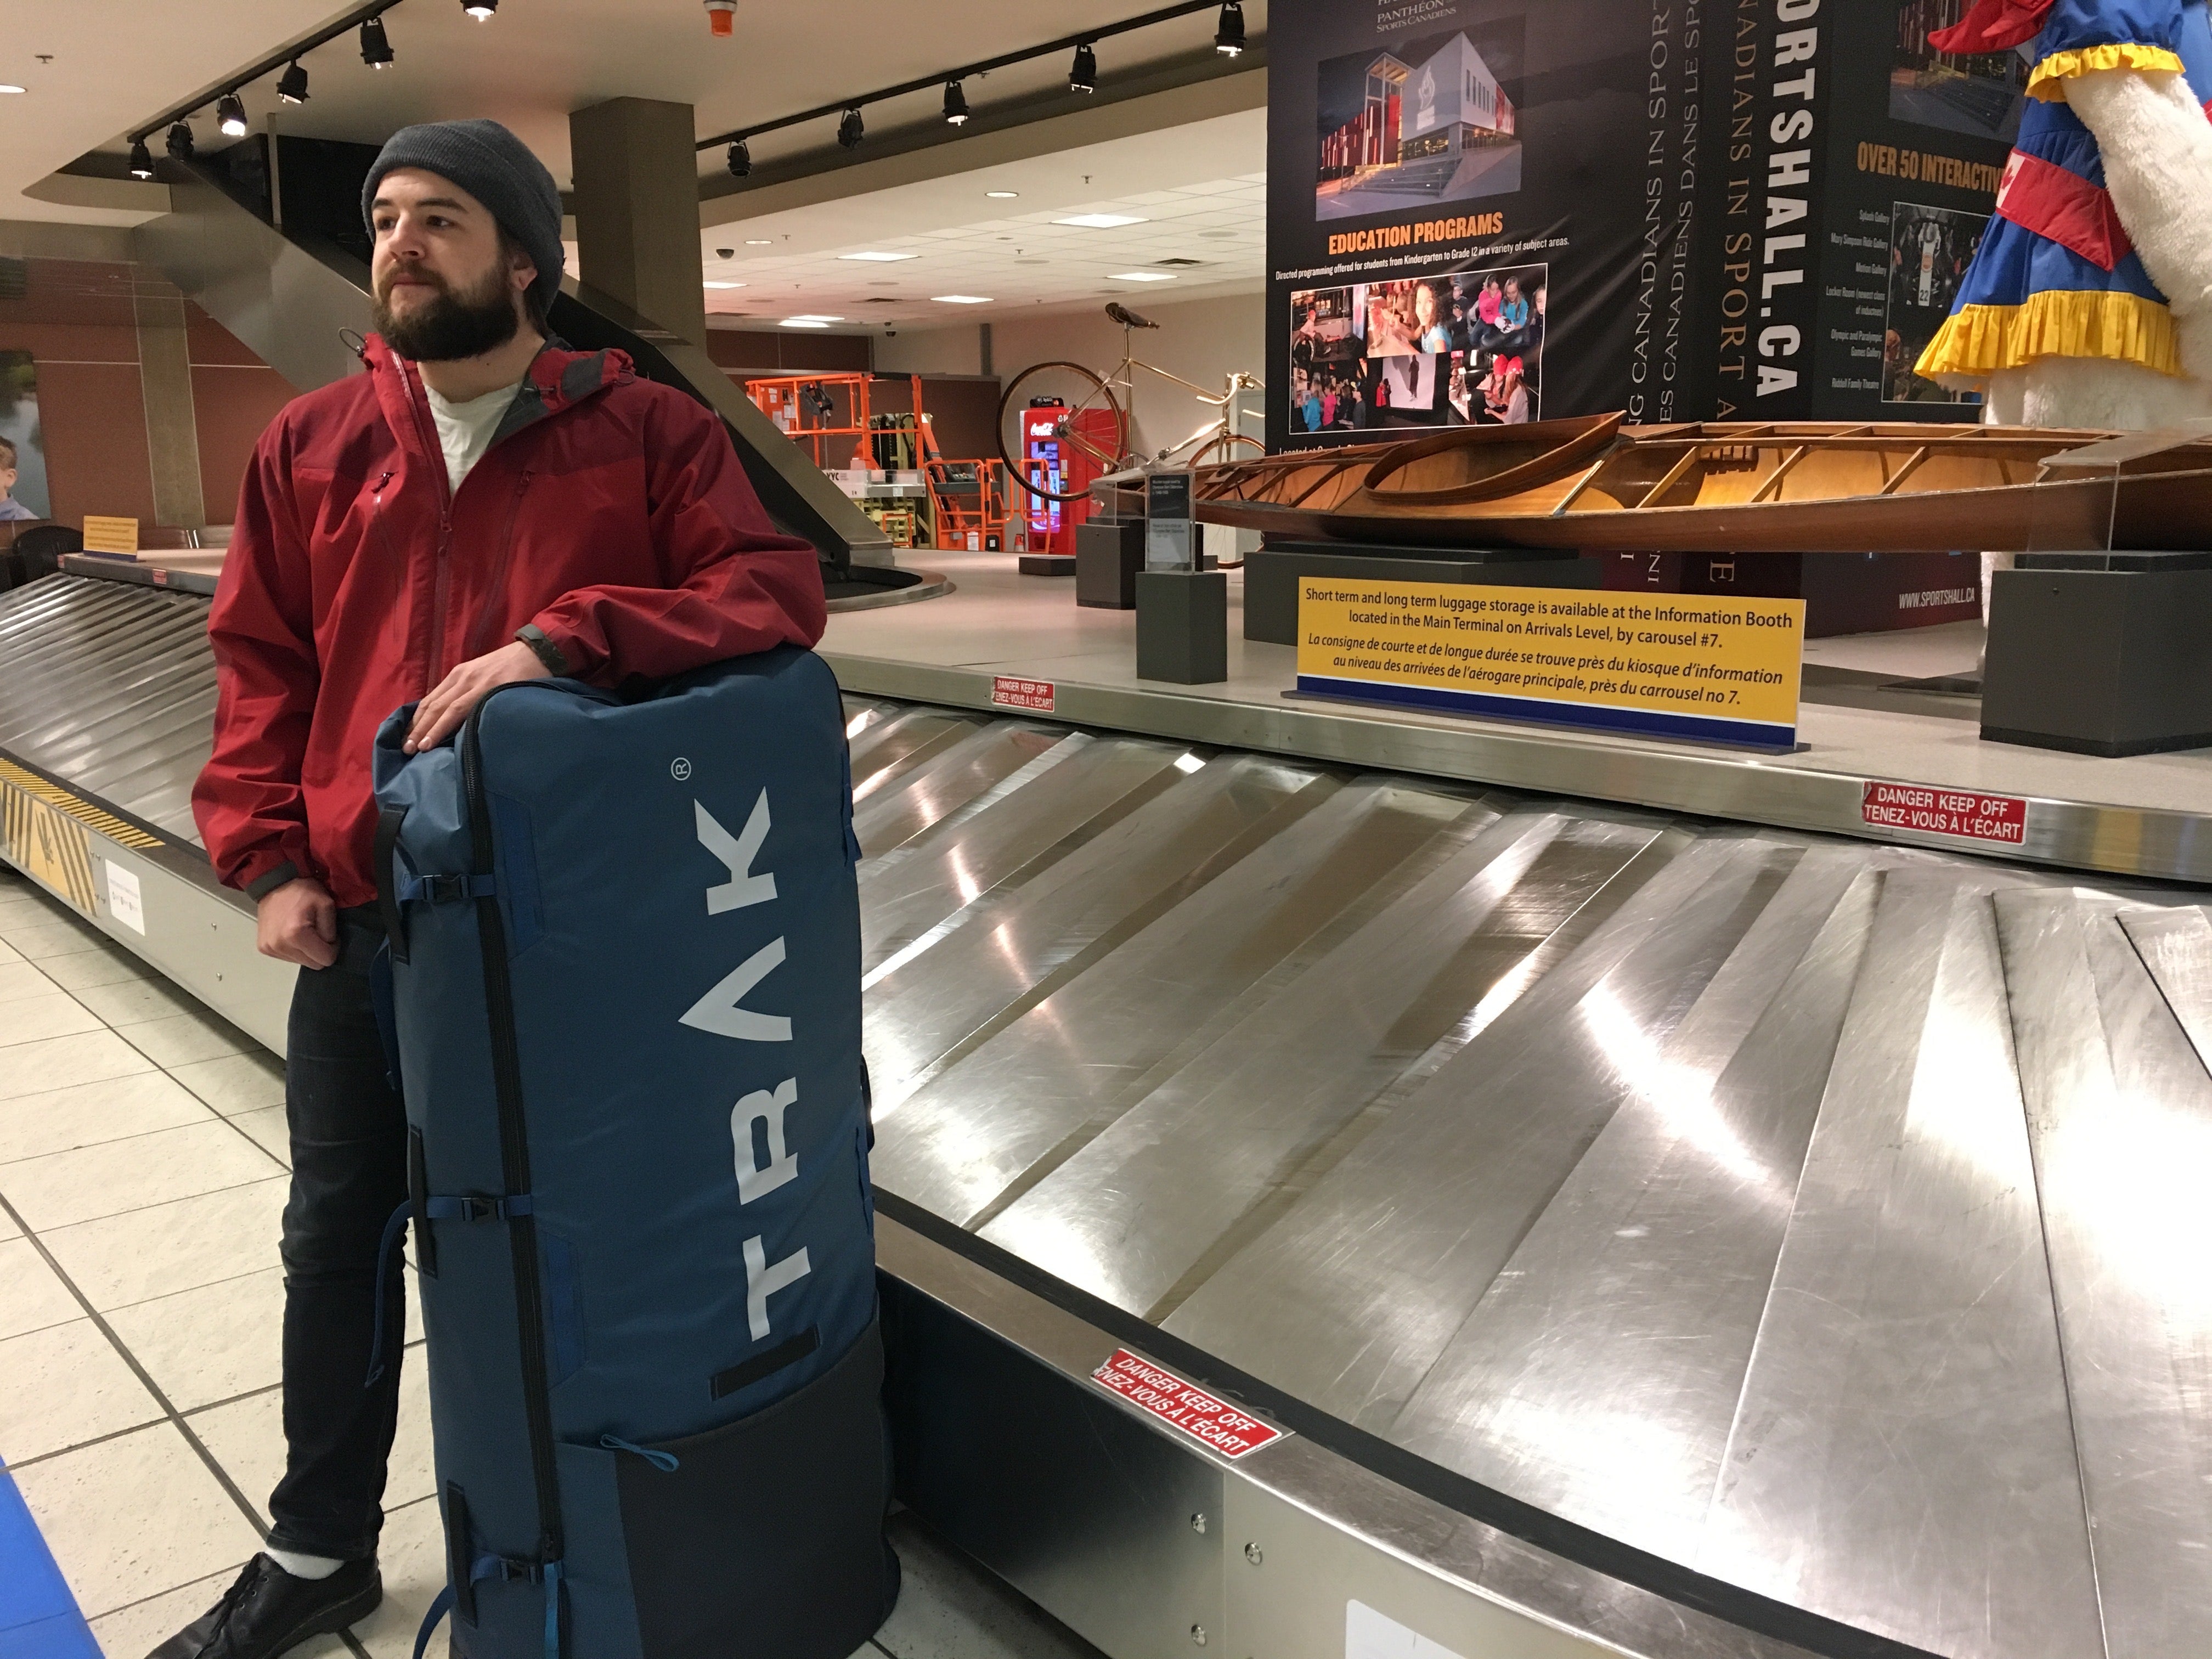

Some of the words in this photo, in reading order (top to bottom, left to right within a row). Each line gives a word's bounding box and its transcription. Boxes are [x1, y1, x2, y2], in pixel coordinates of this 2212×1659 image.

[1376, 19, 1407, 33] SPORTS
[1408, 7, 1456, 25] CANADIENS
[1378, 0, 1444, 23] PANTHÉON
[1685, 57, 1699, 94] LE
[1680, 104, 1699, 191] DANS
[1858, 141, 1897, 176] OVER
[1900, 149, 1919, 179] 50
[1921, 153, 2006, 195] INTERACTIV
[1728, 177, 1750, 215] IN
[1329, 224, 1410, 255] EDUCATION
[1414, 211, 1503, 244] PROGRAMS
[1276, 268, 1297, 280] Directed
[1298, 266, 1333, 279] programming
[1334, 262, 1353, 274] offered
[1364, 258, 1389, 270] students
[1389, 257, 1403, 267] from
[1404, 252, 1442, 265] Kindergarten
[1443, 251, 1451, 259] to
[1452, 247, 1470, 259] Grade
[1479, 246, 1486, 256] in
[1491, 242, 1514, 255] variety
[1515, 241, 1522, 251] of
[1522, 239, 1547, 251] subject
[1549, 237, 1570, 247] areas.
[1632, 177, 1662, 383] CANADIANS
[1648, 129, 1664, 166] IN
[1663, 200, 1693, 381] CANADIENS
[1719, 233, 1752, 380] SPORT
[1920, 289, 1929, 301] 22
[1660, 390, 1673, 423] ES
[1306, 588, 1333, 601] Short
[1335, 591, 1359, 602] term
[1362, 592, 1381, 604] and
[1384, 592, 1408, 609] long
[1411, 596, 1436, 607] term
[1440, 595, 1487, 613] luggage
[1489, 600, 1535, 616] storage
[1538, 601, 1547, 614] is
[1550, 602, 1609, 618] available
[1612, 606, 1625, 619] at
[1629, 605, 1651, 620] the
[1655, 607, 1741, 625] Information
[1746, 611, 1792, 628] Booth
[1899, 587, 1975, 610] WWW.SPORTSHALL.CA
[1350, 610, 1387, 624] located
[1390, 613, 1400, 625] in
[1403, 613, 1420, 627] the
[1423, 615, 1451, 629] Main
[1453, 617, 1503, 632] Terminal
[1506, 623, 1522, 634] on
[1525, 622, 1572, 637] Arrivals
[1576, 625, 1613, 642] Level,
[1617, 627, 1633, 645] by
[1637, 631, 1696, 646] carousel
[1701, 634, 1723, 648] #7.
[1309, 633, 1319, 645] La
[1322, 635, 1365, 651] consigne
[1367, 637, 1379, 650] de
[1381, 639, 1414, 653] courte
[1417, 643, 1427, 654] et
[1429, 642, 1442, 656] de
[1444, 643, 1483, 661] longue
[1485, 647, 1519, 662] durée
[1521, 653, 1533, 664] se
[1536, 652, 1576, 667] trouve
[1577, 656, 1604, 671] près
[1607, 657, 1624, 671] du
[1627, 658, 1679, 678] kiosque
[1683, 662, 1783, 685] d'information
[997, 680, 1019, 692] DANGER
[1020, 682, 1035, 694] KEEP
[1036, 685, 1048, 695] OFF
[1025, 693, 1030, 705] À
[1334, 656, 1346, 666] au
[1348, 657, 1381, 670] niveau
[1384, 659, 1401, 672] des
[1403, 662, 1445, 676] arrivées
[1447, 664, 1461, 678] de
[1463, 665, 1521, 685] l'aérogare
[1522, 673, 1587, 692] principale,
[1589, 679, 1617, 694] près
[1620, 680, 1637, 695] du
[1640, 686, 1703, 702] carrousel
[1706, 691, 1725, 703] no
[1728, 690, 1741, 705] 7.
[1865, 804, 1947, 830] TENEZ-VOUS
[1949, 811, 1960, 832] À
[1963, 815, 2021, 839] L'ÉCART
[1878, 787, 1933, 808] DANGER
[1939, 794, 1976, 813] KEEP
[1980, 799, 2008, 817] OFF
[678, 786, 811, 1342] TRAK
[1115, 1358, 1181, 1393] DANGER
[1175, 1389, 1223, 1414] KEEP
[1217, 1413, 1257, 1432] OFF
[1165, 1405, 1186, 1419] À
[1178, 1413, 1250, 1452] L'ÉCART
